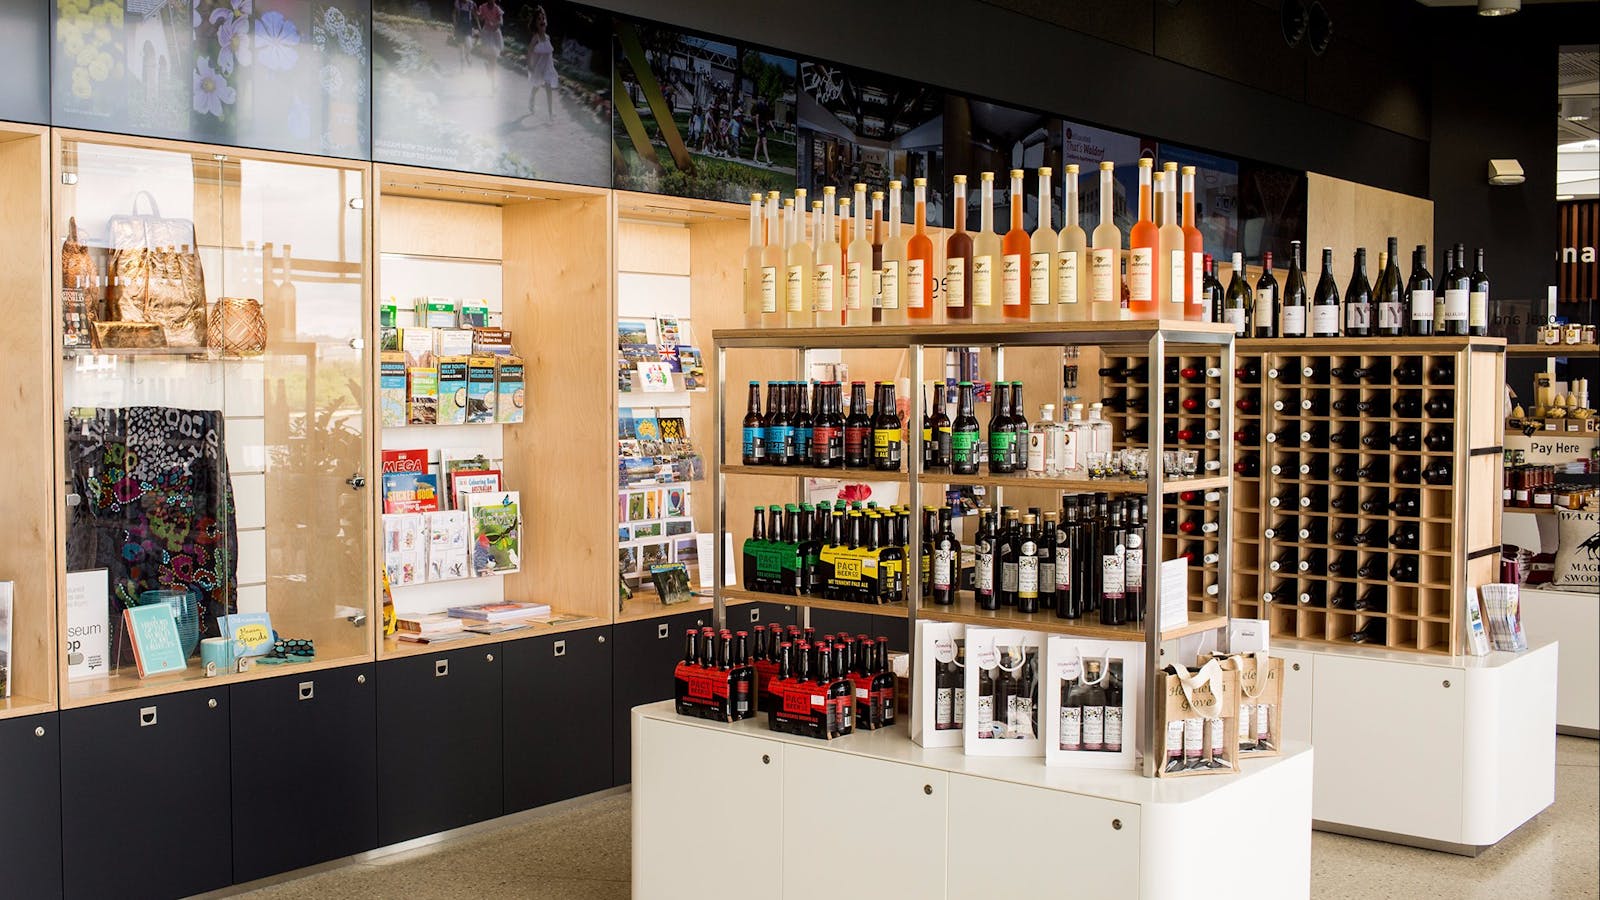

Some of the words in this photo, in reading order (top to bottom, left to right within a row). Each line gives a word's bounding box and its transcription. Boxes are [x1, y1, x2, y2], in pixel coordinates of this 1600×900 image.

[1067, 141, 1083, 153] That's
[1083, 143, 1105, 161] Waldorf
[1555, 246, 1596, 263] na
[1587, 420, 1593, 430] 6
[1530, 442, 1552, 456] Pay
[1556, 442, 1580, 453] Here
[382, 459, 423, 473] MEGA
[387, 490, 416, 501] STICKER
[416, 489, 435, 500] BOOK
[1561, 513, 1600, 521] WAR
[837, 562, 859, 571] PACT
[1564, 574, 1600, 582] SWOO
[860, 581, 869, 589] ALE
[785, 694, 807, 704] PACT
